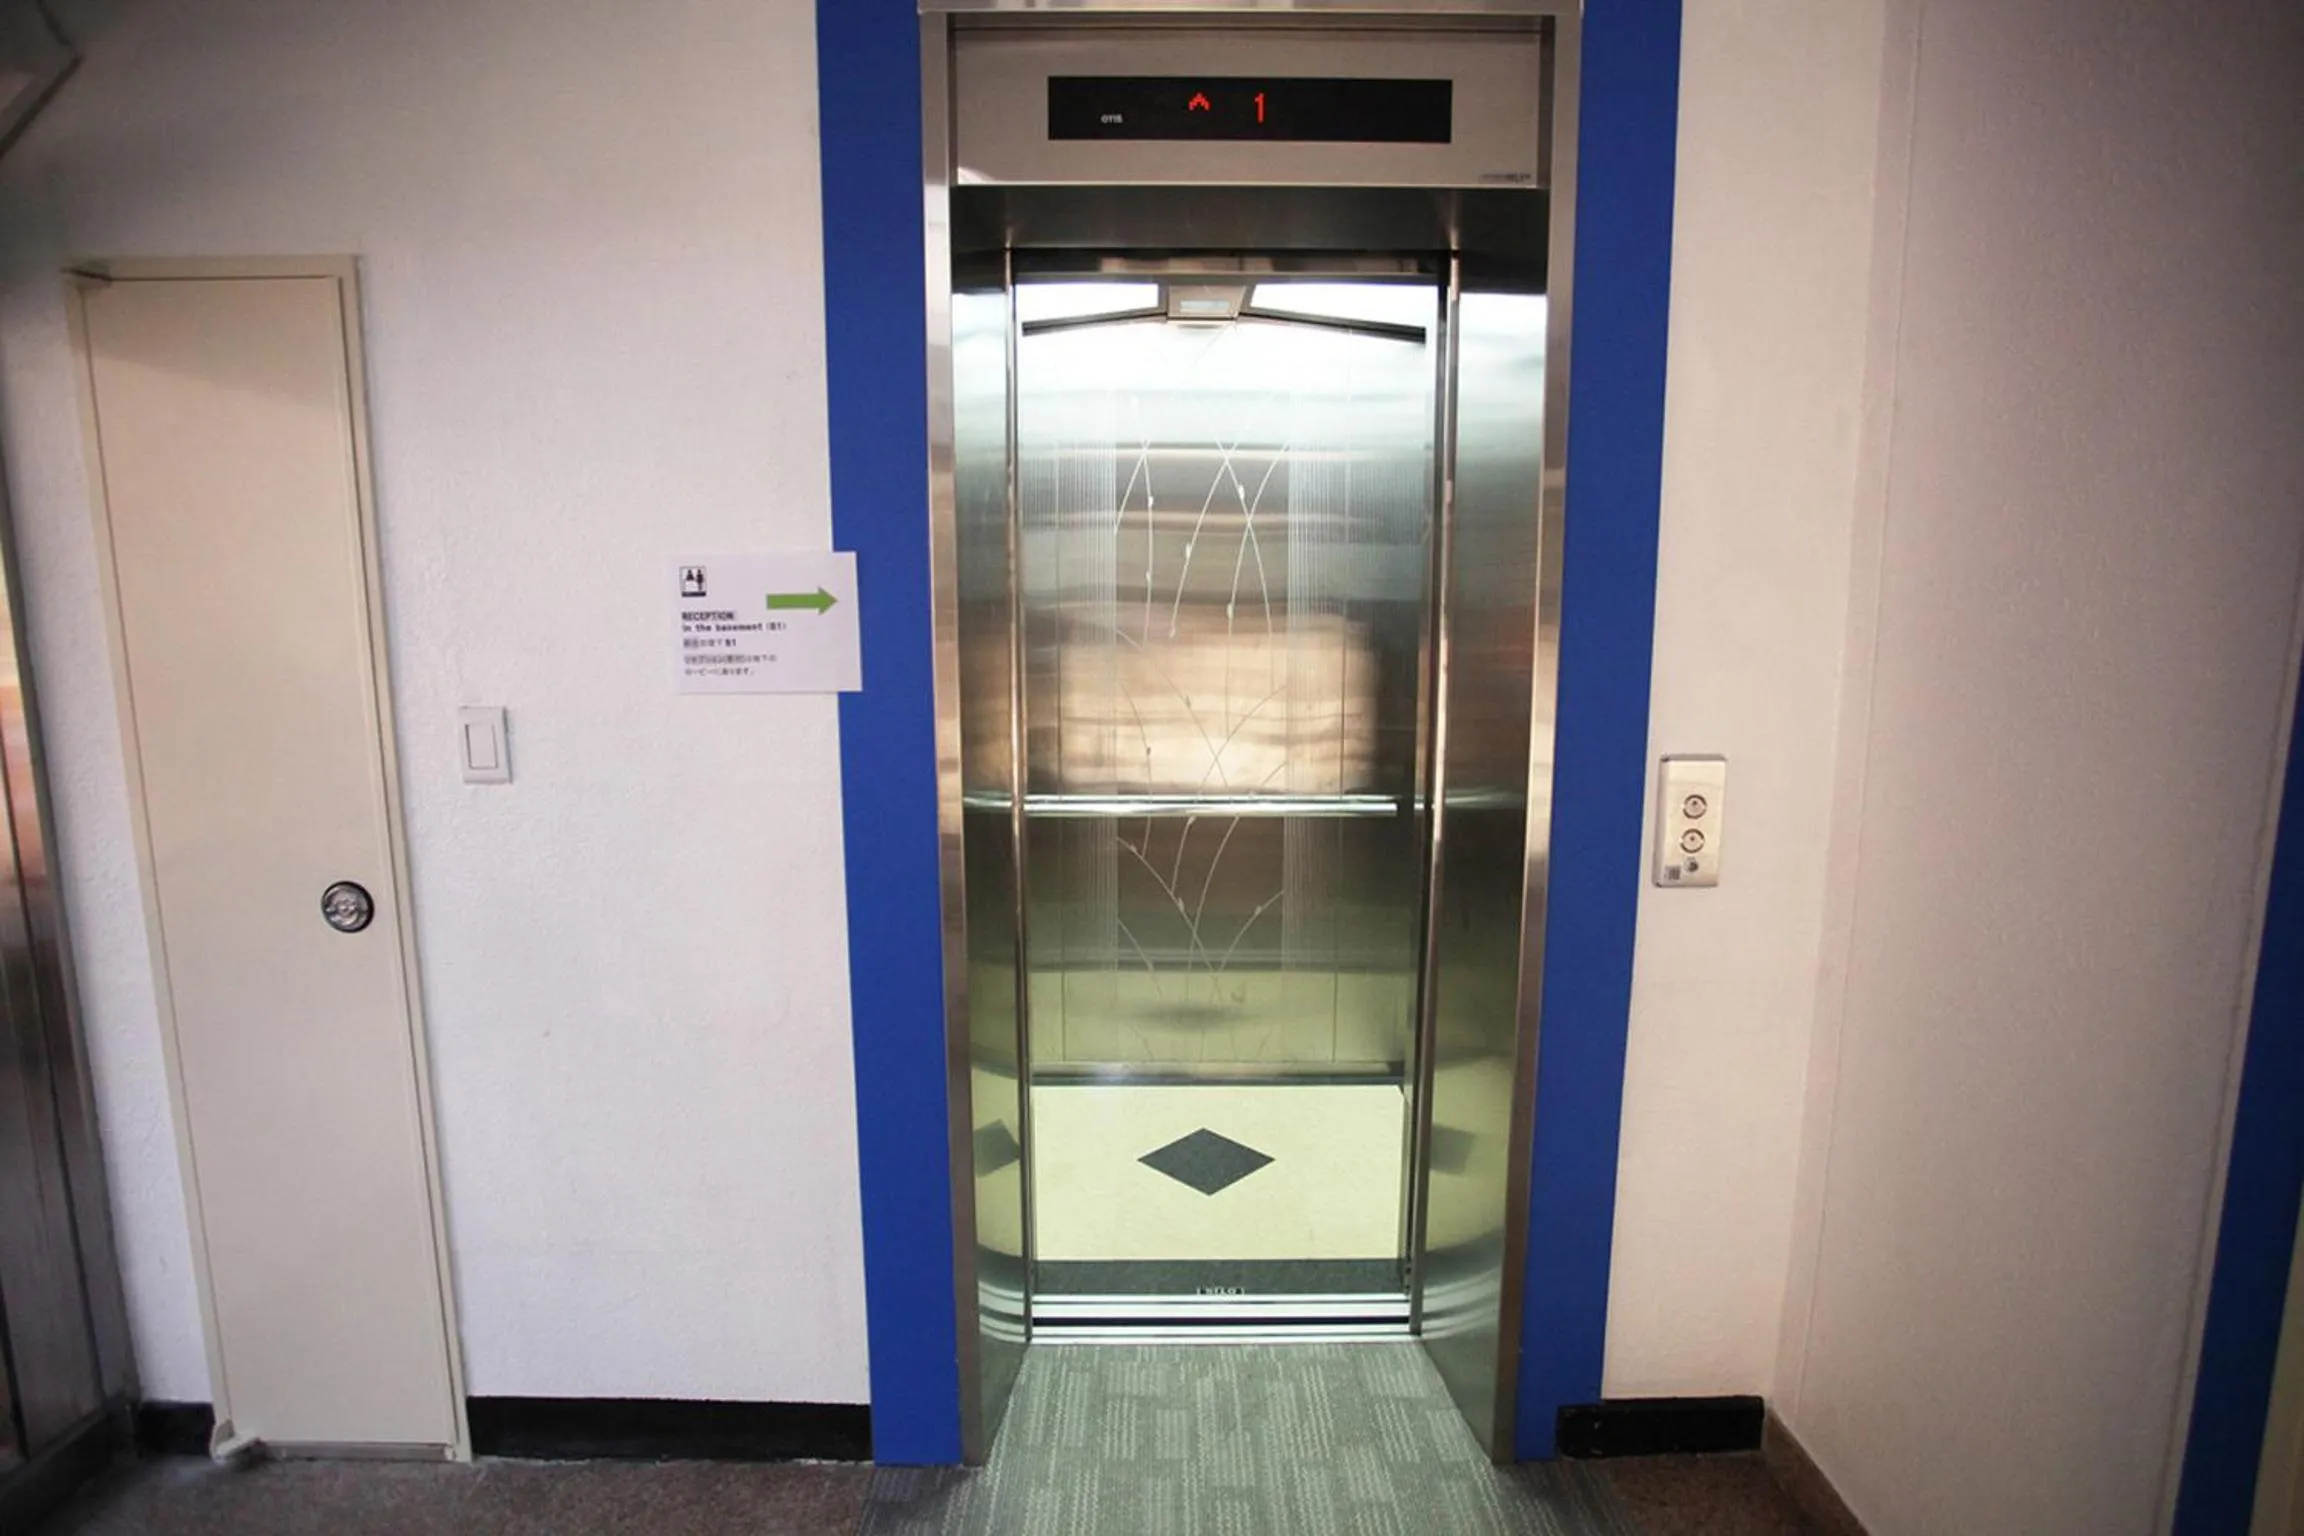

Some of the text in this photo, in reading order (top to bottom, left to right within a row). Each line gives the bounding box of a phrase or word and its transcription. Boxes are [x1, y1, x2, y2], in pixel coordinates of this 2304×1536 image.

[1254, 93, 1264, 123] 1
[682, 611, 734, 620] RECEPTION
[682, 623, 692, 632] in
[695, 623, 712, 631] the
[715, 622, 762, 632] basement
